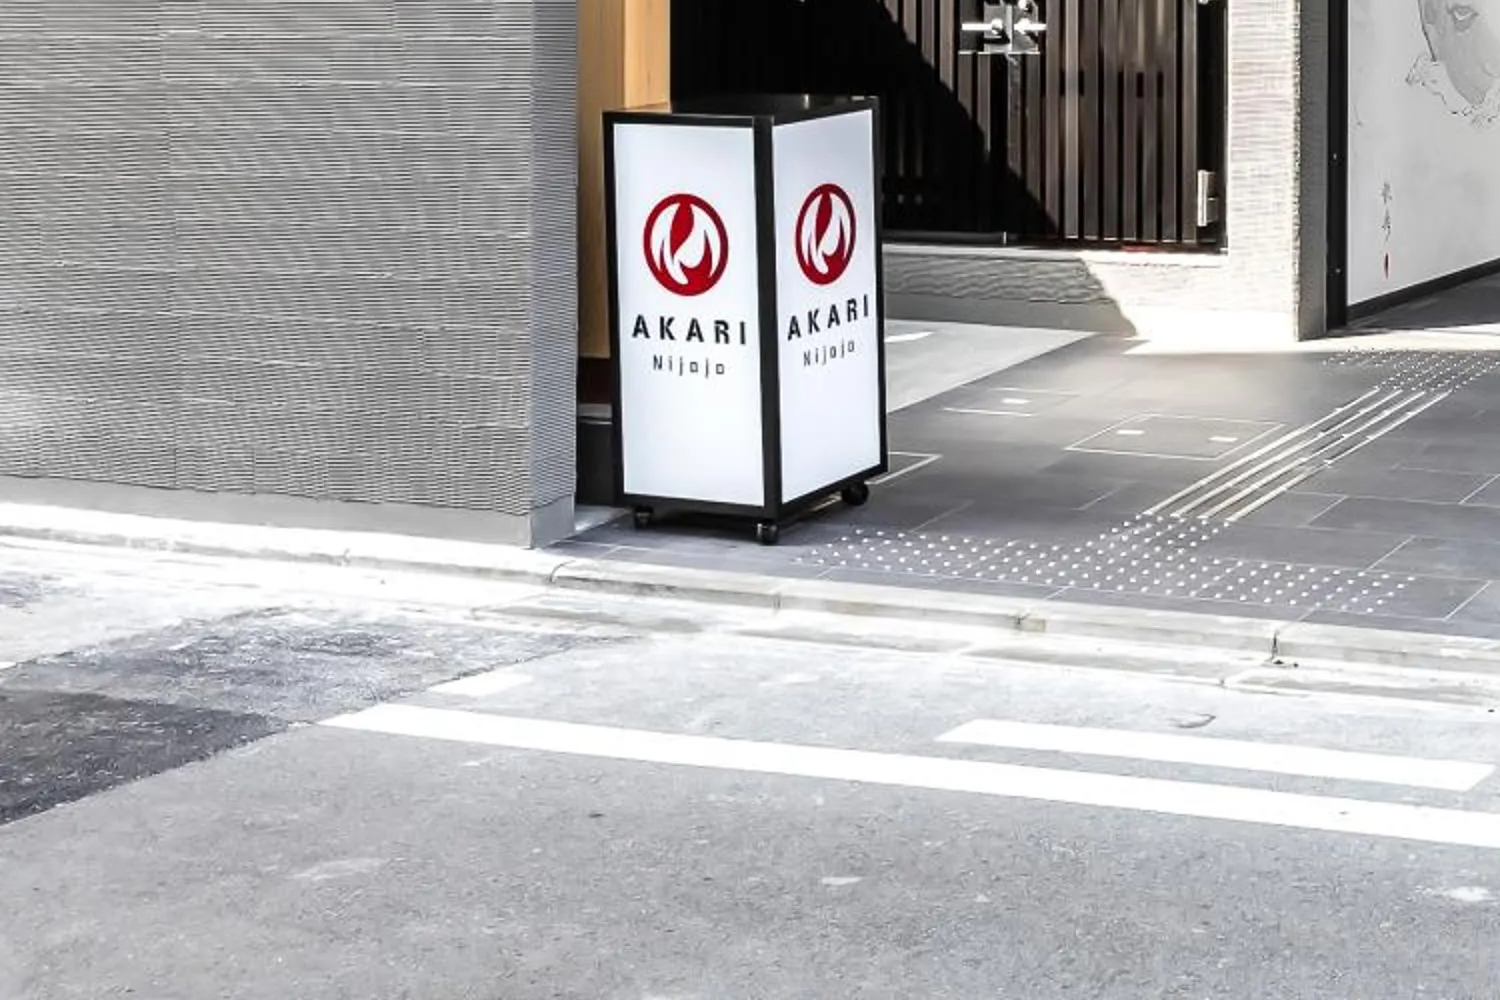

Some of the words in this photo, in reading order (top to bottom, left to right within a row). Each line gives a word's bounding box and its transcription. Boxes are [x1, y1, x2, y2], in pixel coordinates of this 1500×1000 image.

[631, 314, 746, 345] AKARI
[787, 294, 869, 341] AKARI
[652, 355, 726, 378] Nijojo
[803, 340, 856, 366] Nijojo
